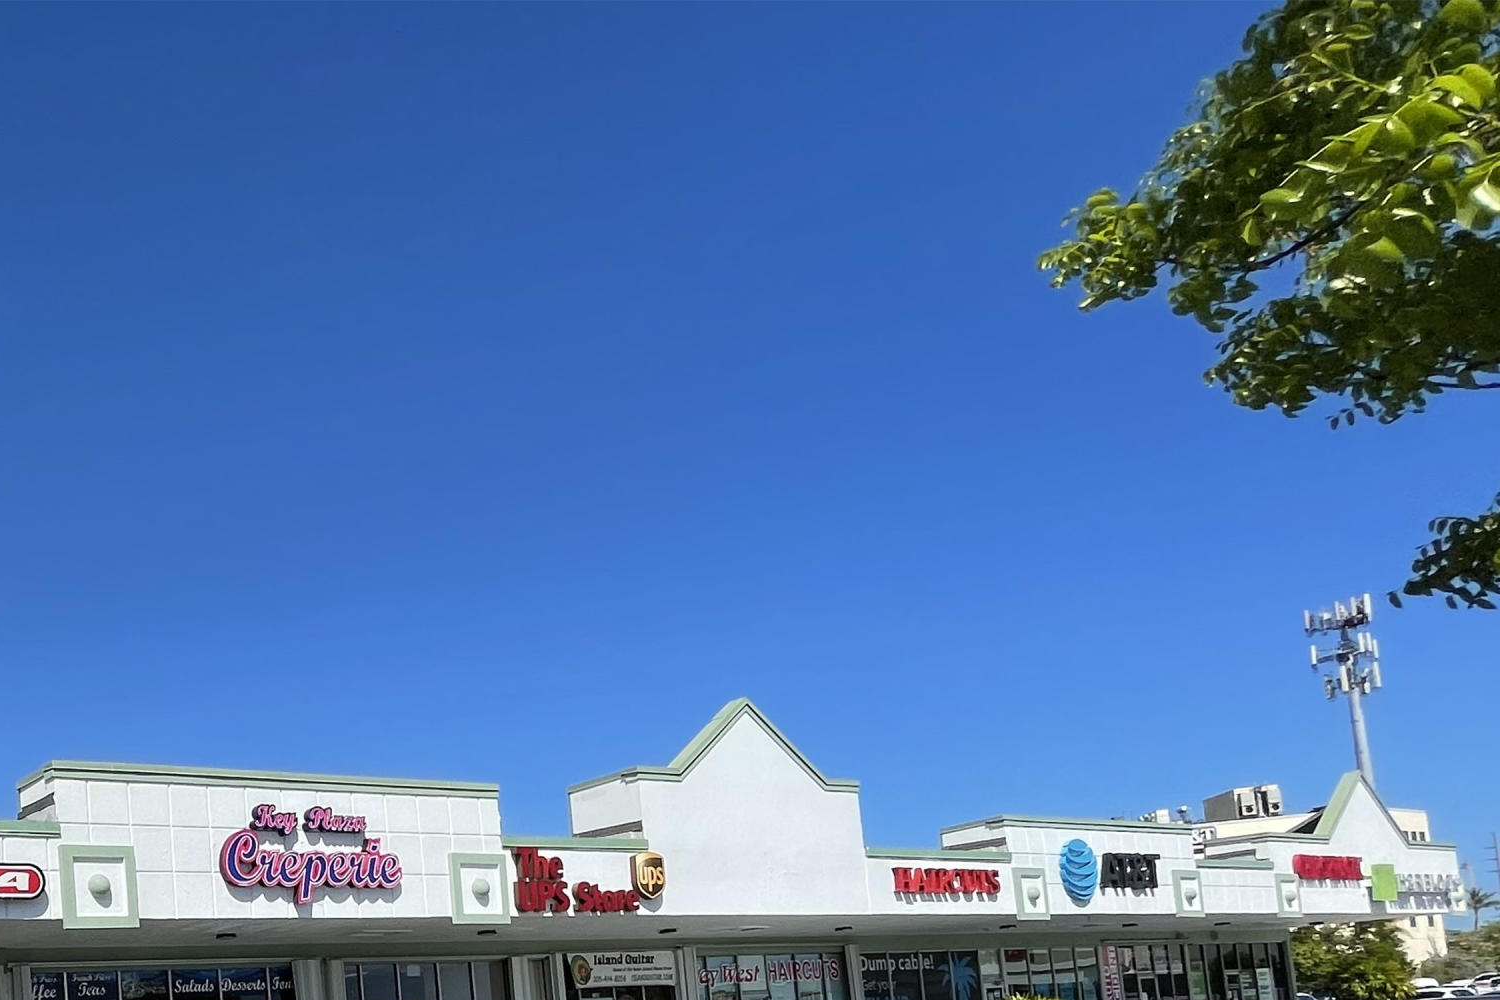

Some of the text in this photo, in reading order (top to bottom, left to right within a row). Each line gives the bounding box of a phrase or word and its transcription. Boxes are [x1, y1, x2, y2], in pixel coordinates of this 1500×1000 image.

[250, 804, 366, 835] Key Plaza
[220, 828, 402, 904] Creperie
[510, 847, 563, 879] The
[639, 865, 665, 893] ups
[514, 880, 640, 912] UPS Store
[594, 954, 654, 966] Island Guitar
[77, 982, 106, 997] Teas
[174, 978, 214, 993] Salads
[221, 977, 266, 992] Desserts
[272, 977, 294, 991] Fon
